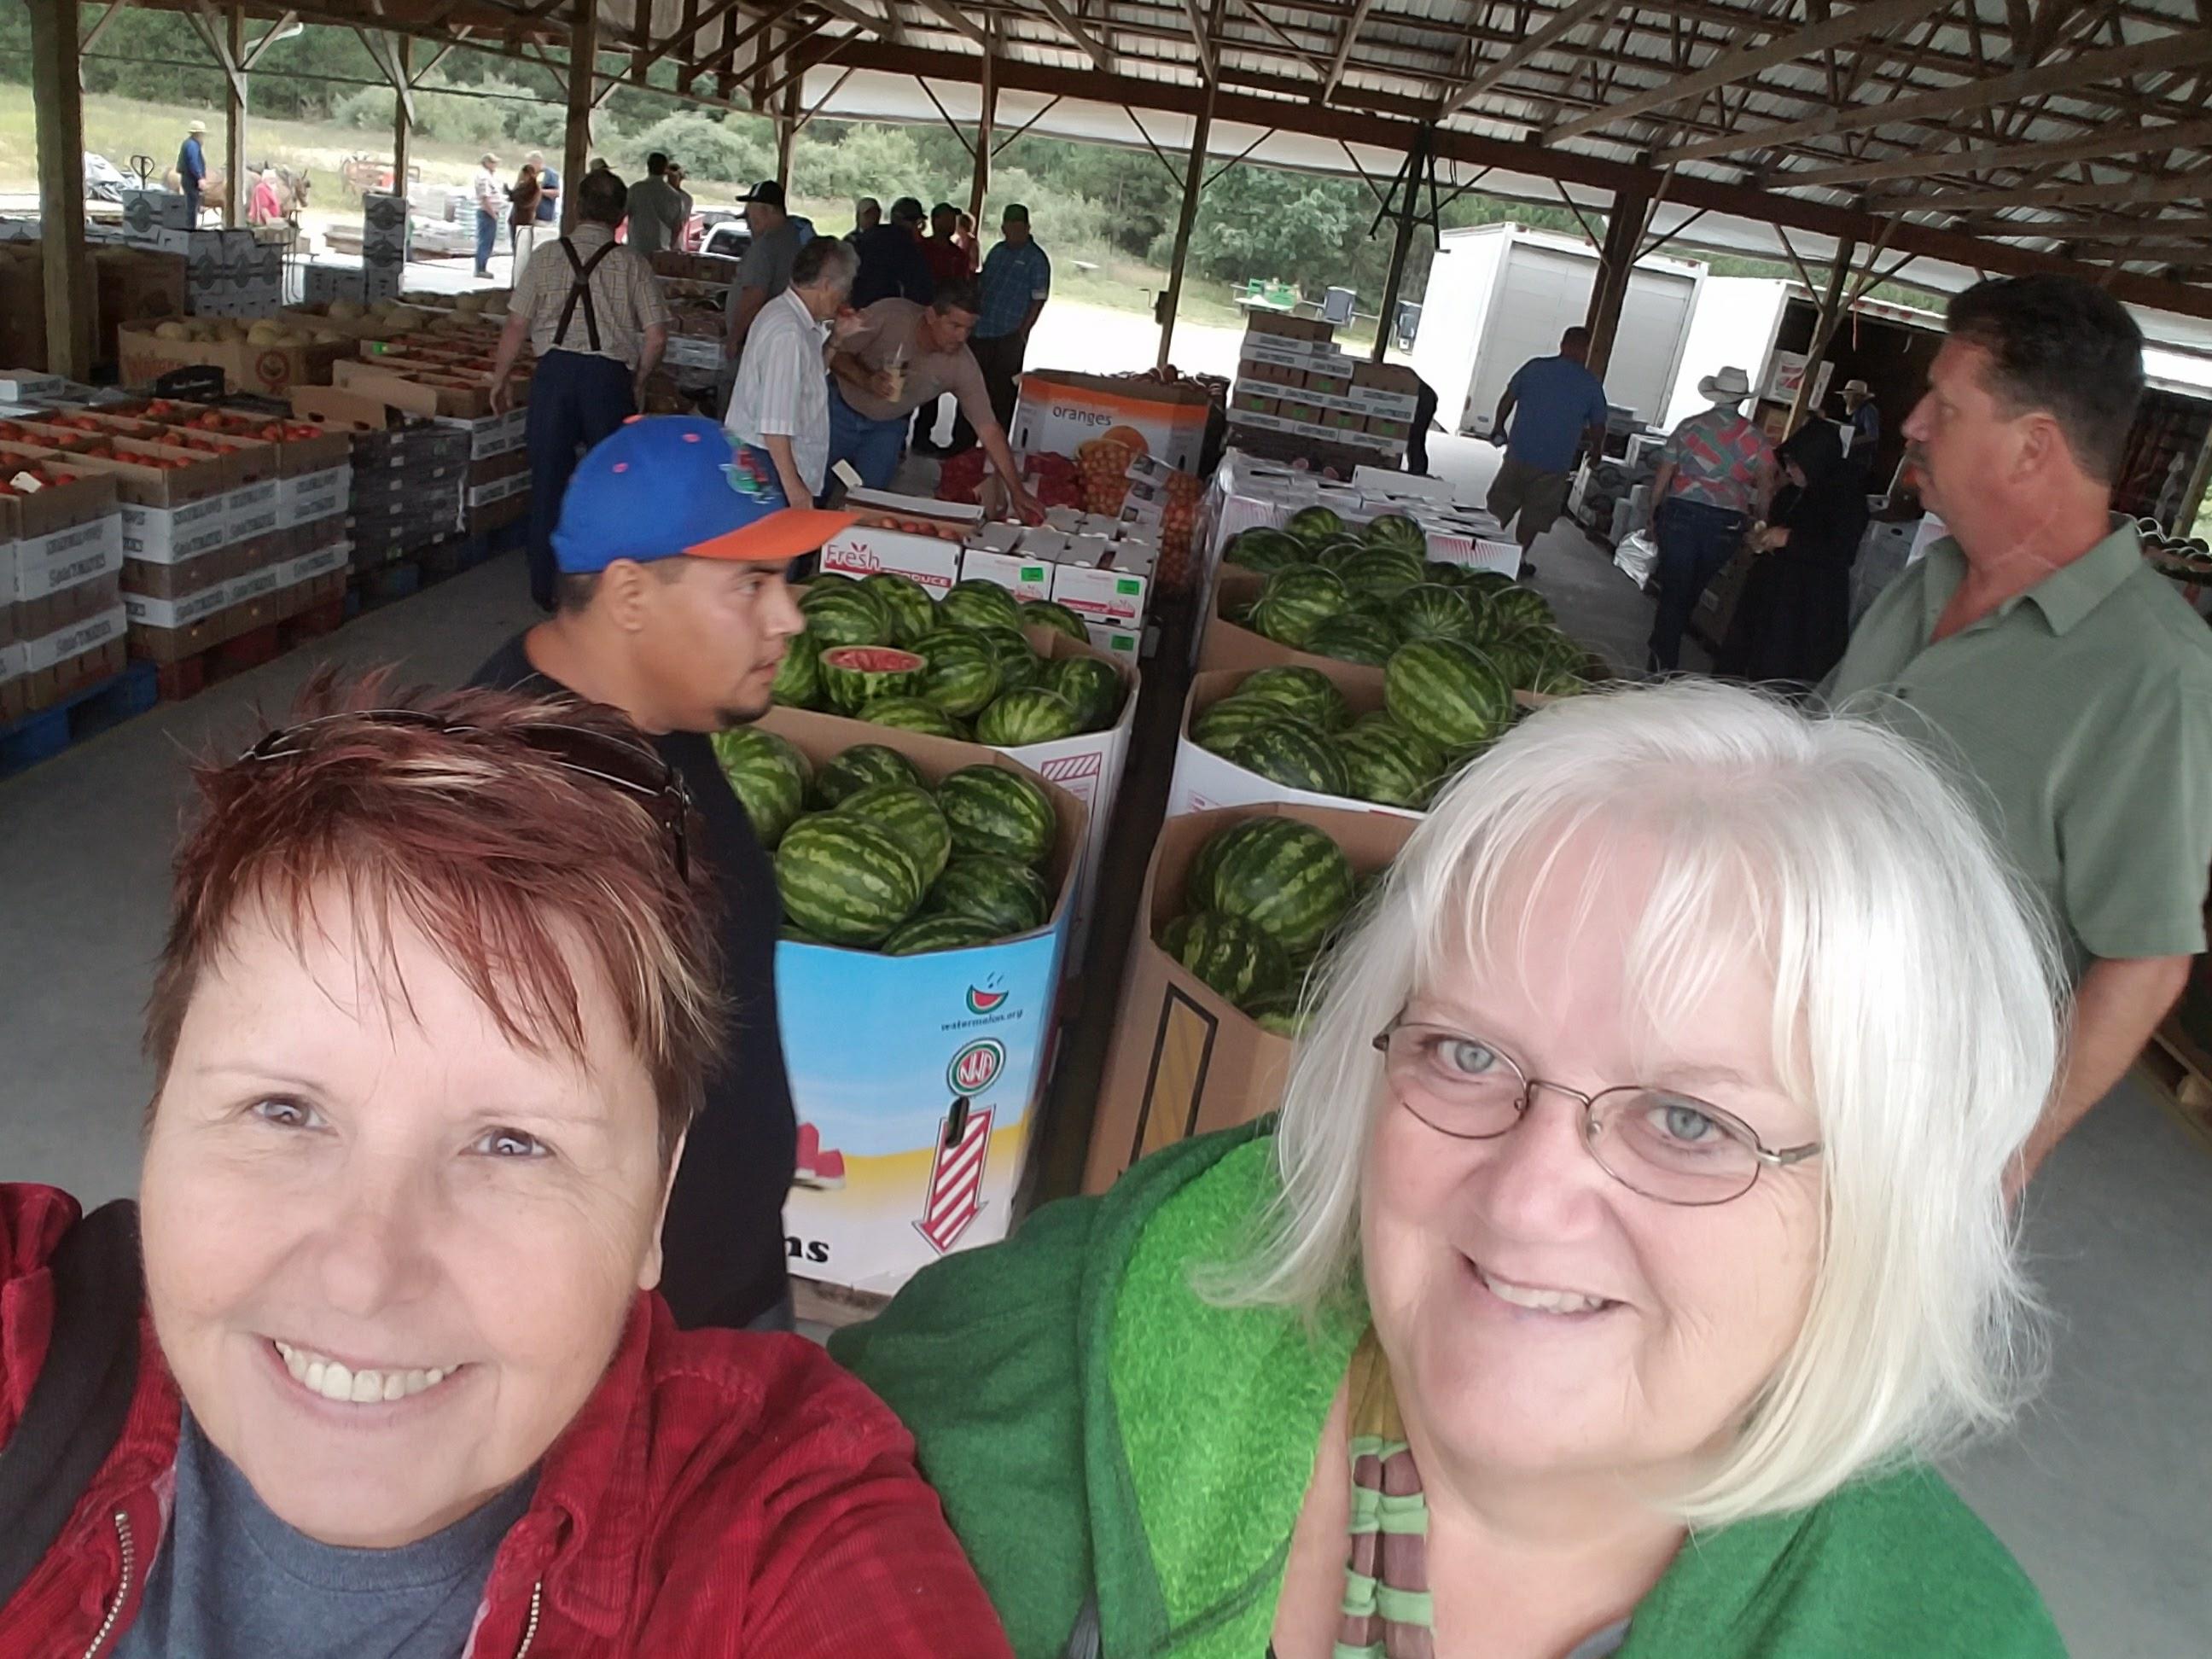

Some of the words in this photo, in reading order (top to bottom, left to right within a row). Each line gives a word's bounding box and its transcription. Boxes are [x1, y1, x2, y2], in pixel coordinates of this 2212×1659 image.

[1053, 406, 1112, 426] oranges
[826, 544, 880, 570] Fresh
[941, 1009, 1023, 1031] watermelon.org
[785, 1236, 830, 1263] ns
